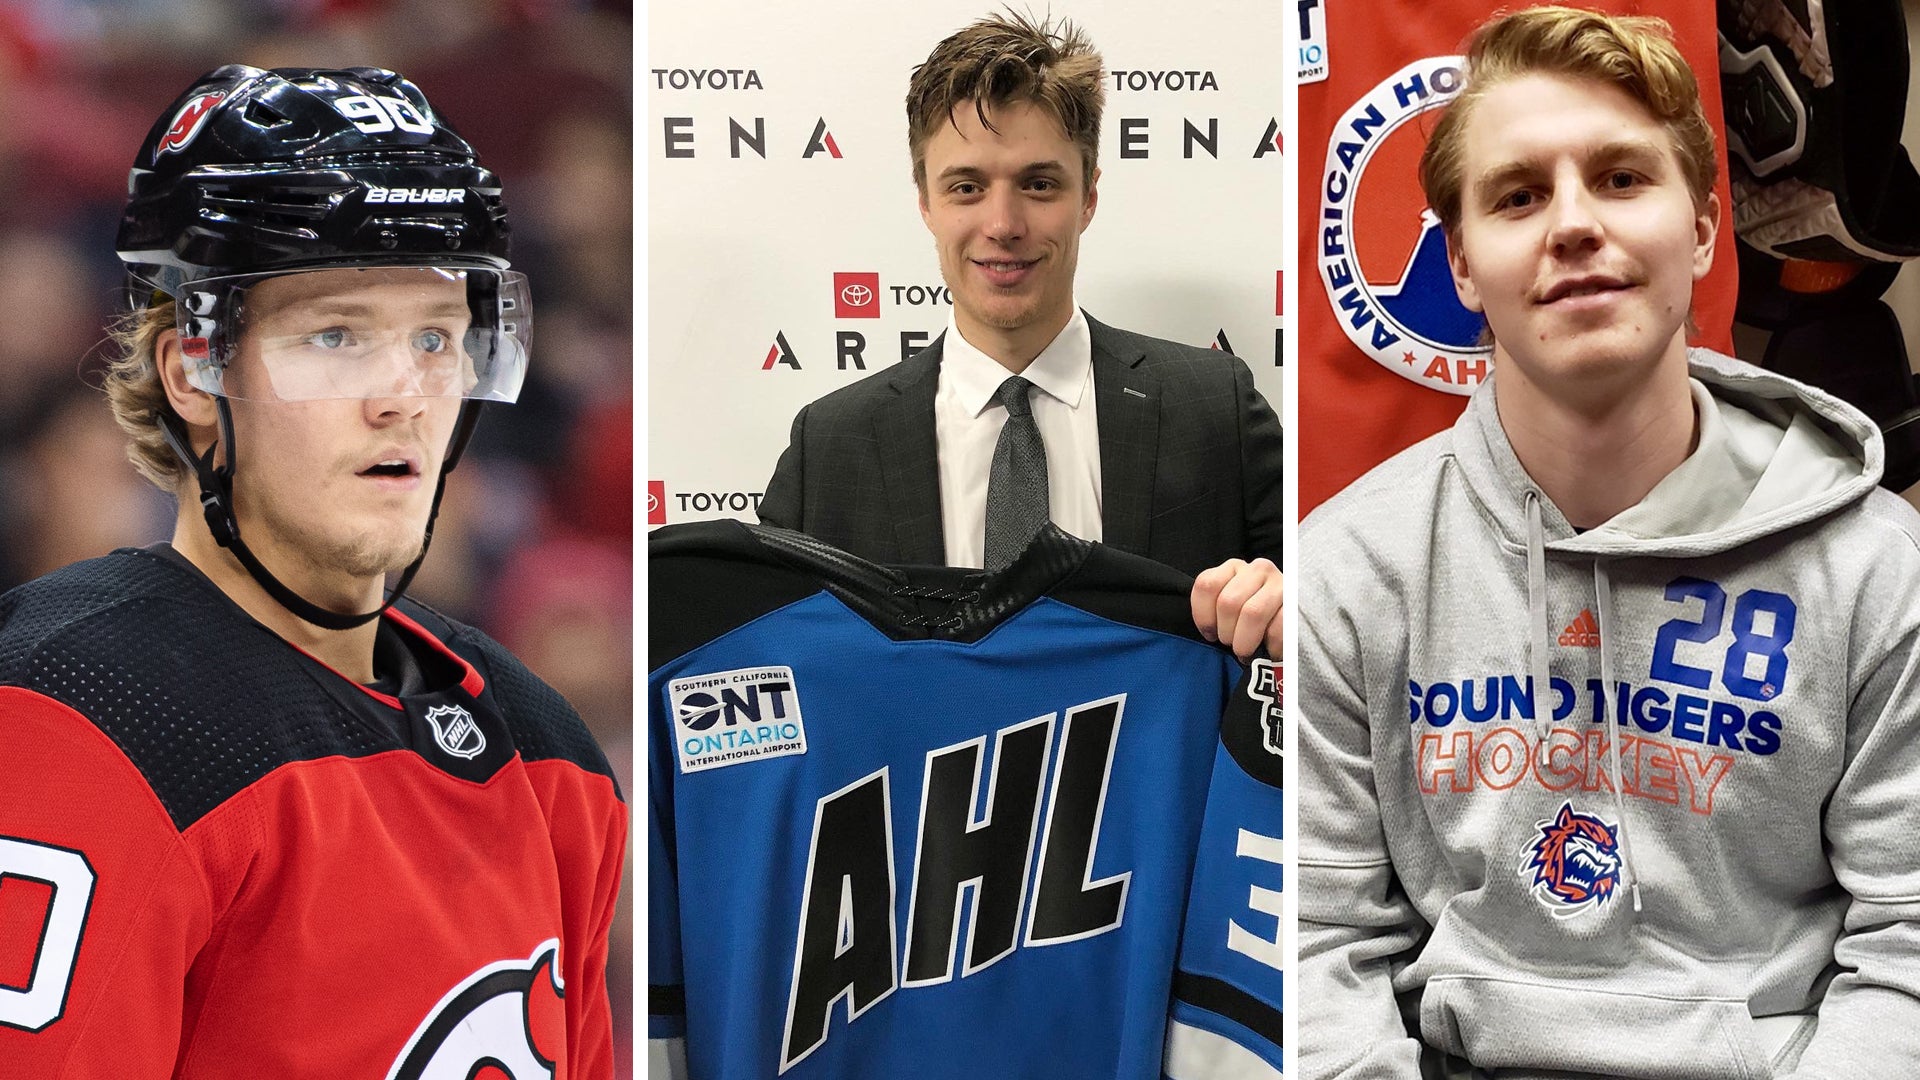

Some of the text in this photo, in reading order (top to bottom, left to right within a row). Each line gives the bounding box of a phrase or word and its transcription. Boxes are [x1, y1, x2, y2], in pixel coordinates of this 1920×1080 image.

[651, 69, 764, 90] TOYOTA
[1111, 70, 1219, 91] TOYOTA
[334, 95, 436, 135] 90
[663, 116, 844, 159] ENA
[1324, 103, 1400, 351] AMERICAN
[675, 492, 763, 511] TOYOT
[1649, 575, 1797, 702] 28
[675, 672, 788, 692] SOUTHERN CALIFORNIA
[447, 718, 469, 748] NHL
[1586, 678, 1783, 756] TIGERS
[684, 723, 799, 756] ONTARIO
[686, 742, 801, 768] INTERNATIONAL AIRPORT
[1417, 727, 1734, 816] HOCKEY
[778, 692, 1132, 1076] AHL
